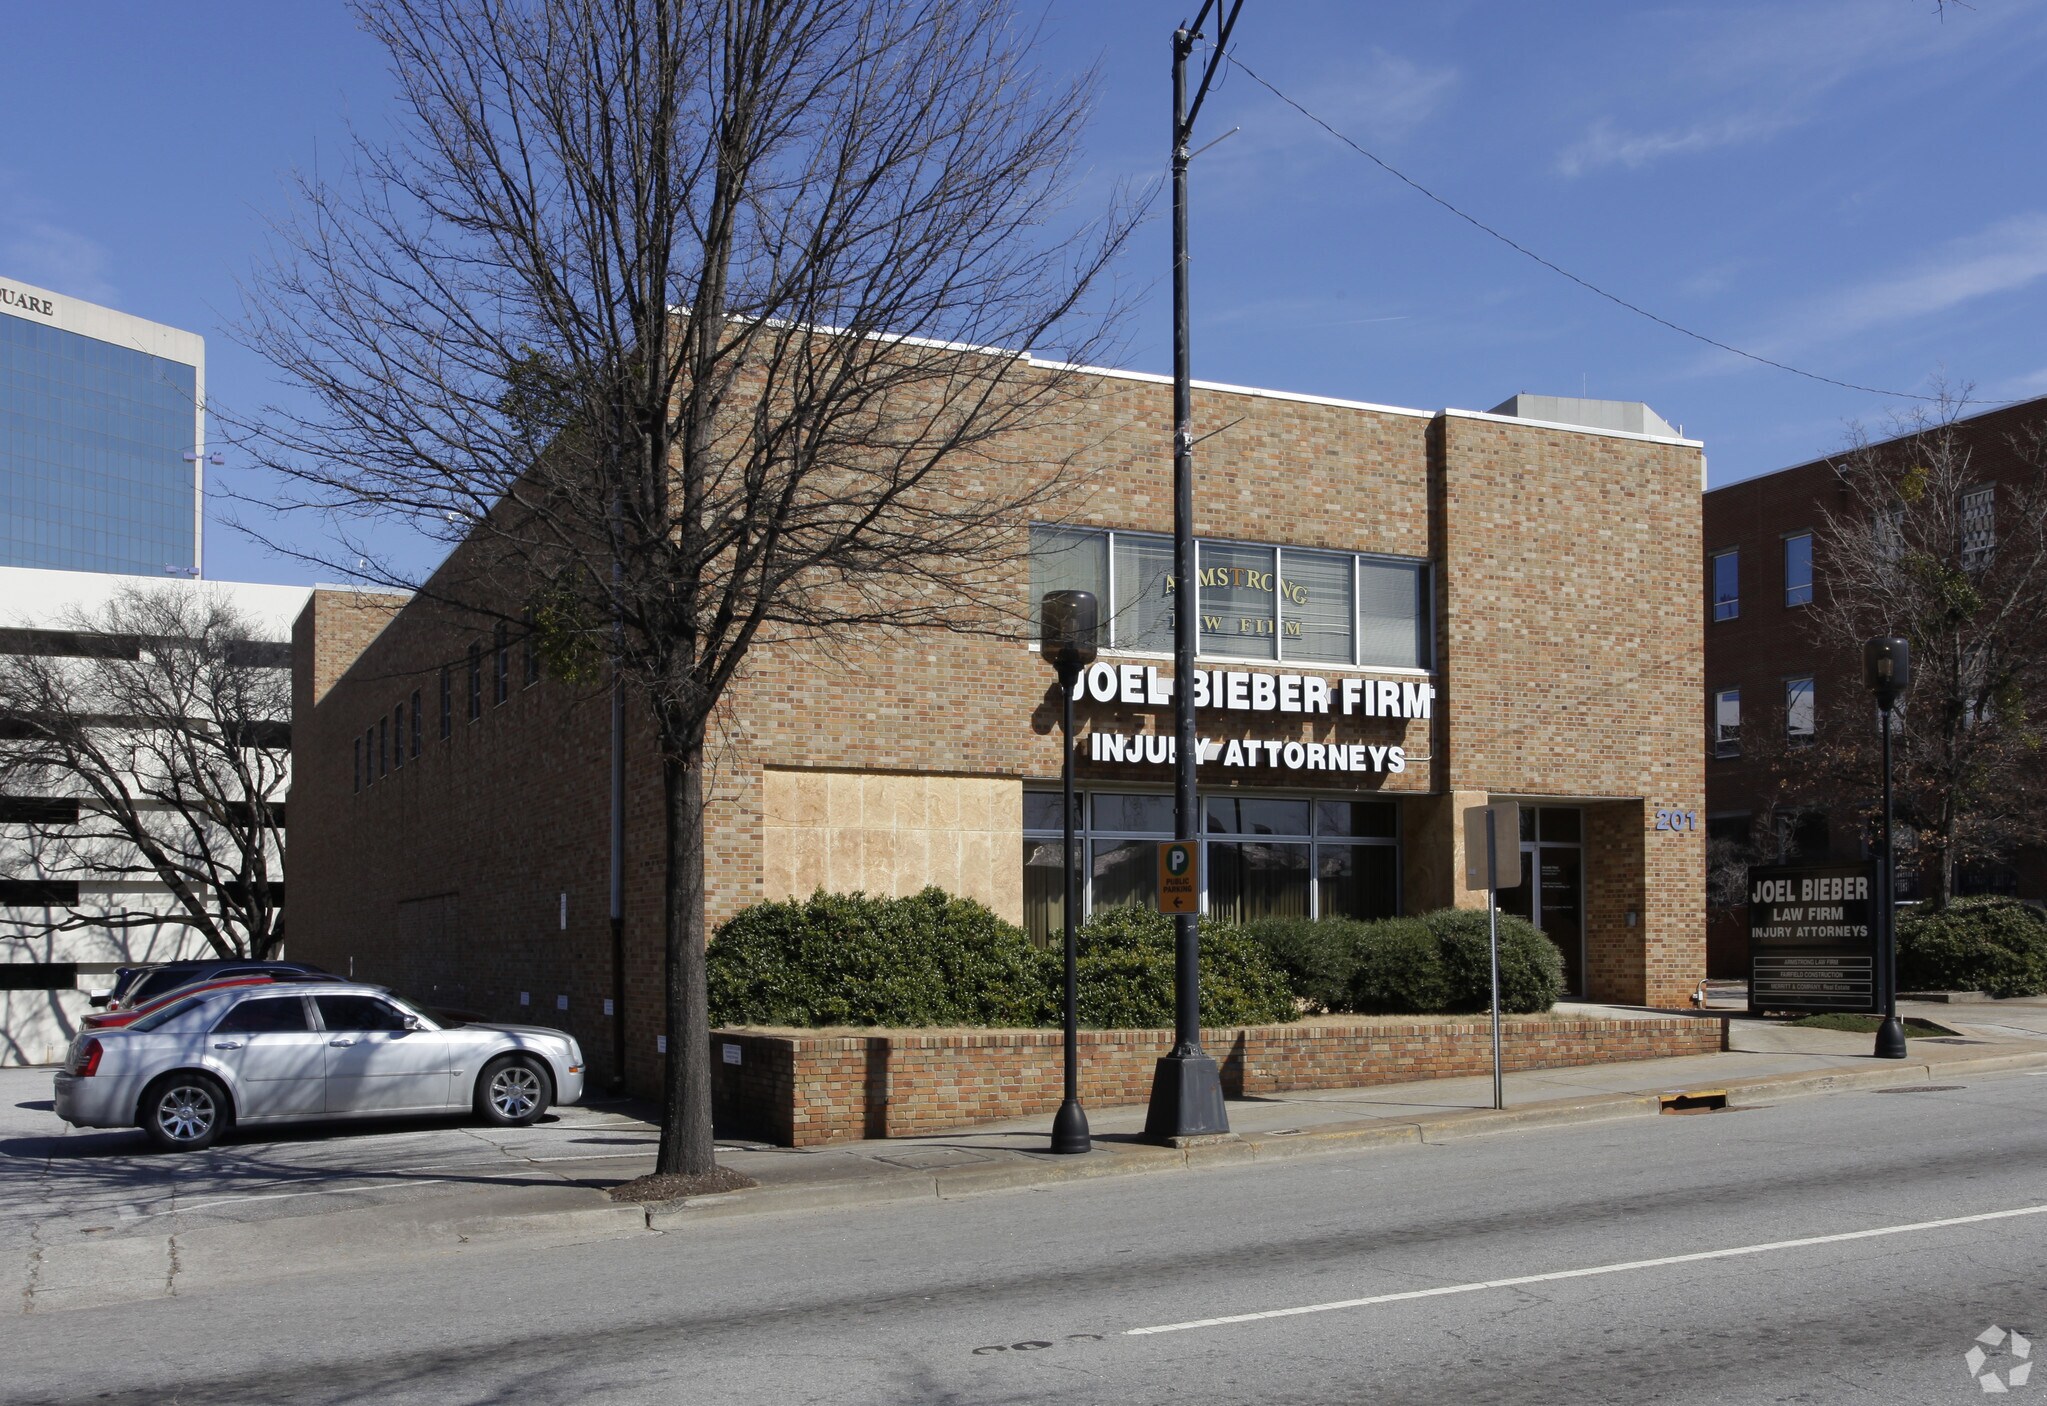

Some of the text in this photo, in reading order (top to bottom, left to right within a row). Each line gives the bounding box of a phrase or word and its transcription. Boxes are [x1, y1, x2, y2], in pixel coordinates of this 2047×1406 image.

[0, 288, 53, 316] UARE
[1165, 567, 1308, 604] AMSTRONG
[1194, 669, 1328, 713] BIEBER
[1342, 678, 1431, 719] FIRM
[1223, 739, 1406, 774] ATTORNEYS
[1656, 809, 1696, 831] 201
[1172, 850, 1185, 871] P
[1163, 885, 1192, 893] PARKING
[1752, 877, 1868, 903] JOEL BIEBER
[1773, 907, 1843, 921] LAW FIRM
[1752, 925, 1868, 937] INJURY ATTORNEYS
